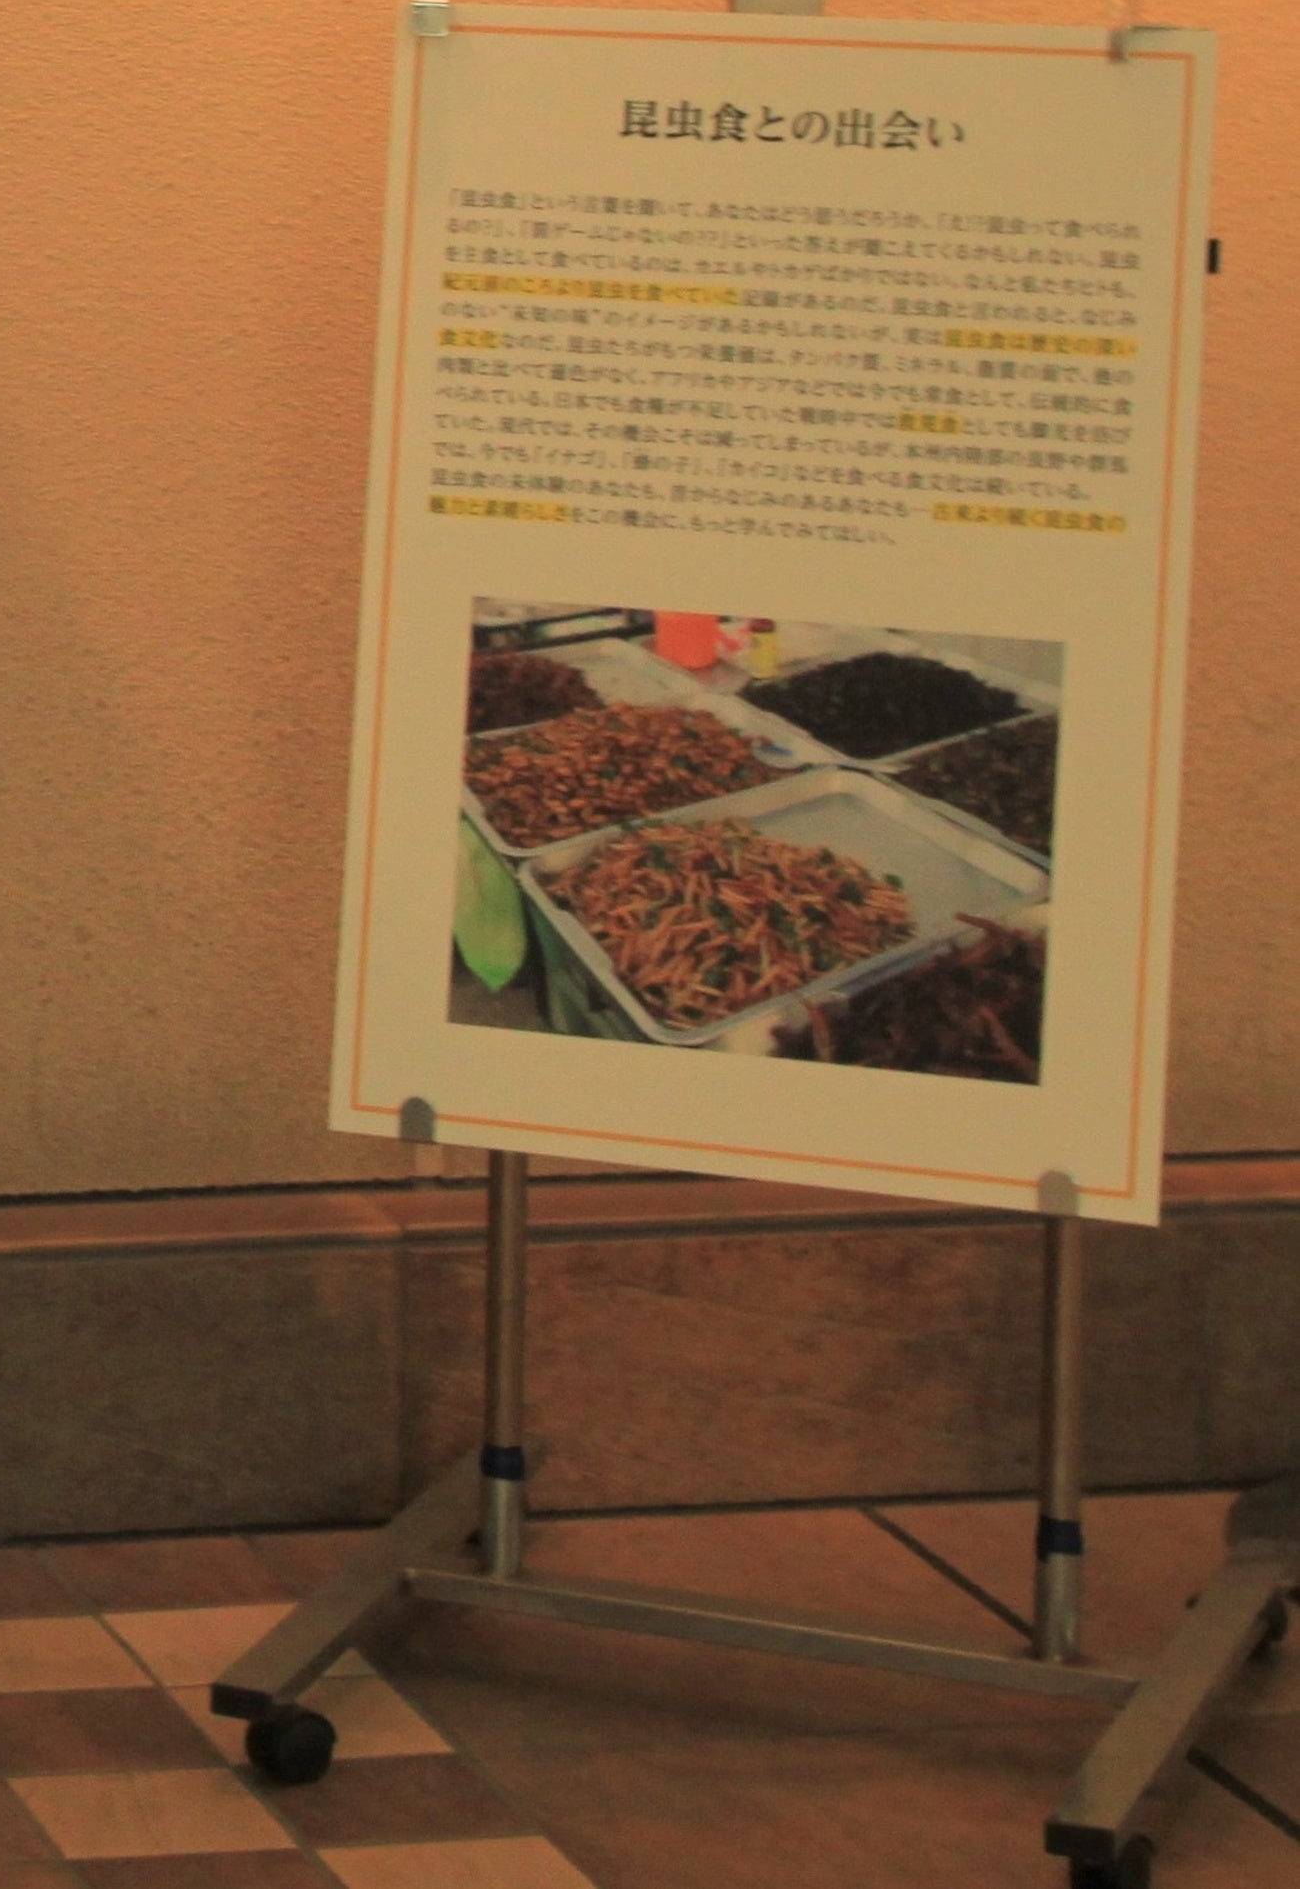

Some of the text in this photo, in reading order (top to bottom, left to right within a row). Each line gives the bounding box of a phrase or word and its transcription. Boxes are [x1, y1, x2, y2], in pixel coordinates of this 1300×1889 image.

[617, 98, 967, 153] 昆虫食との出会い
